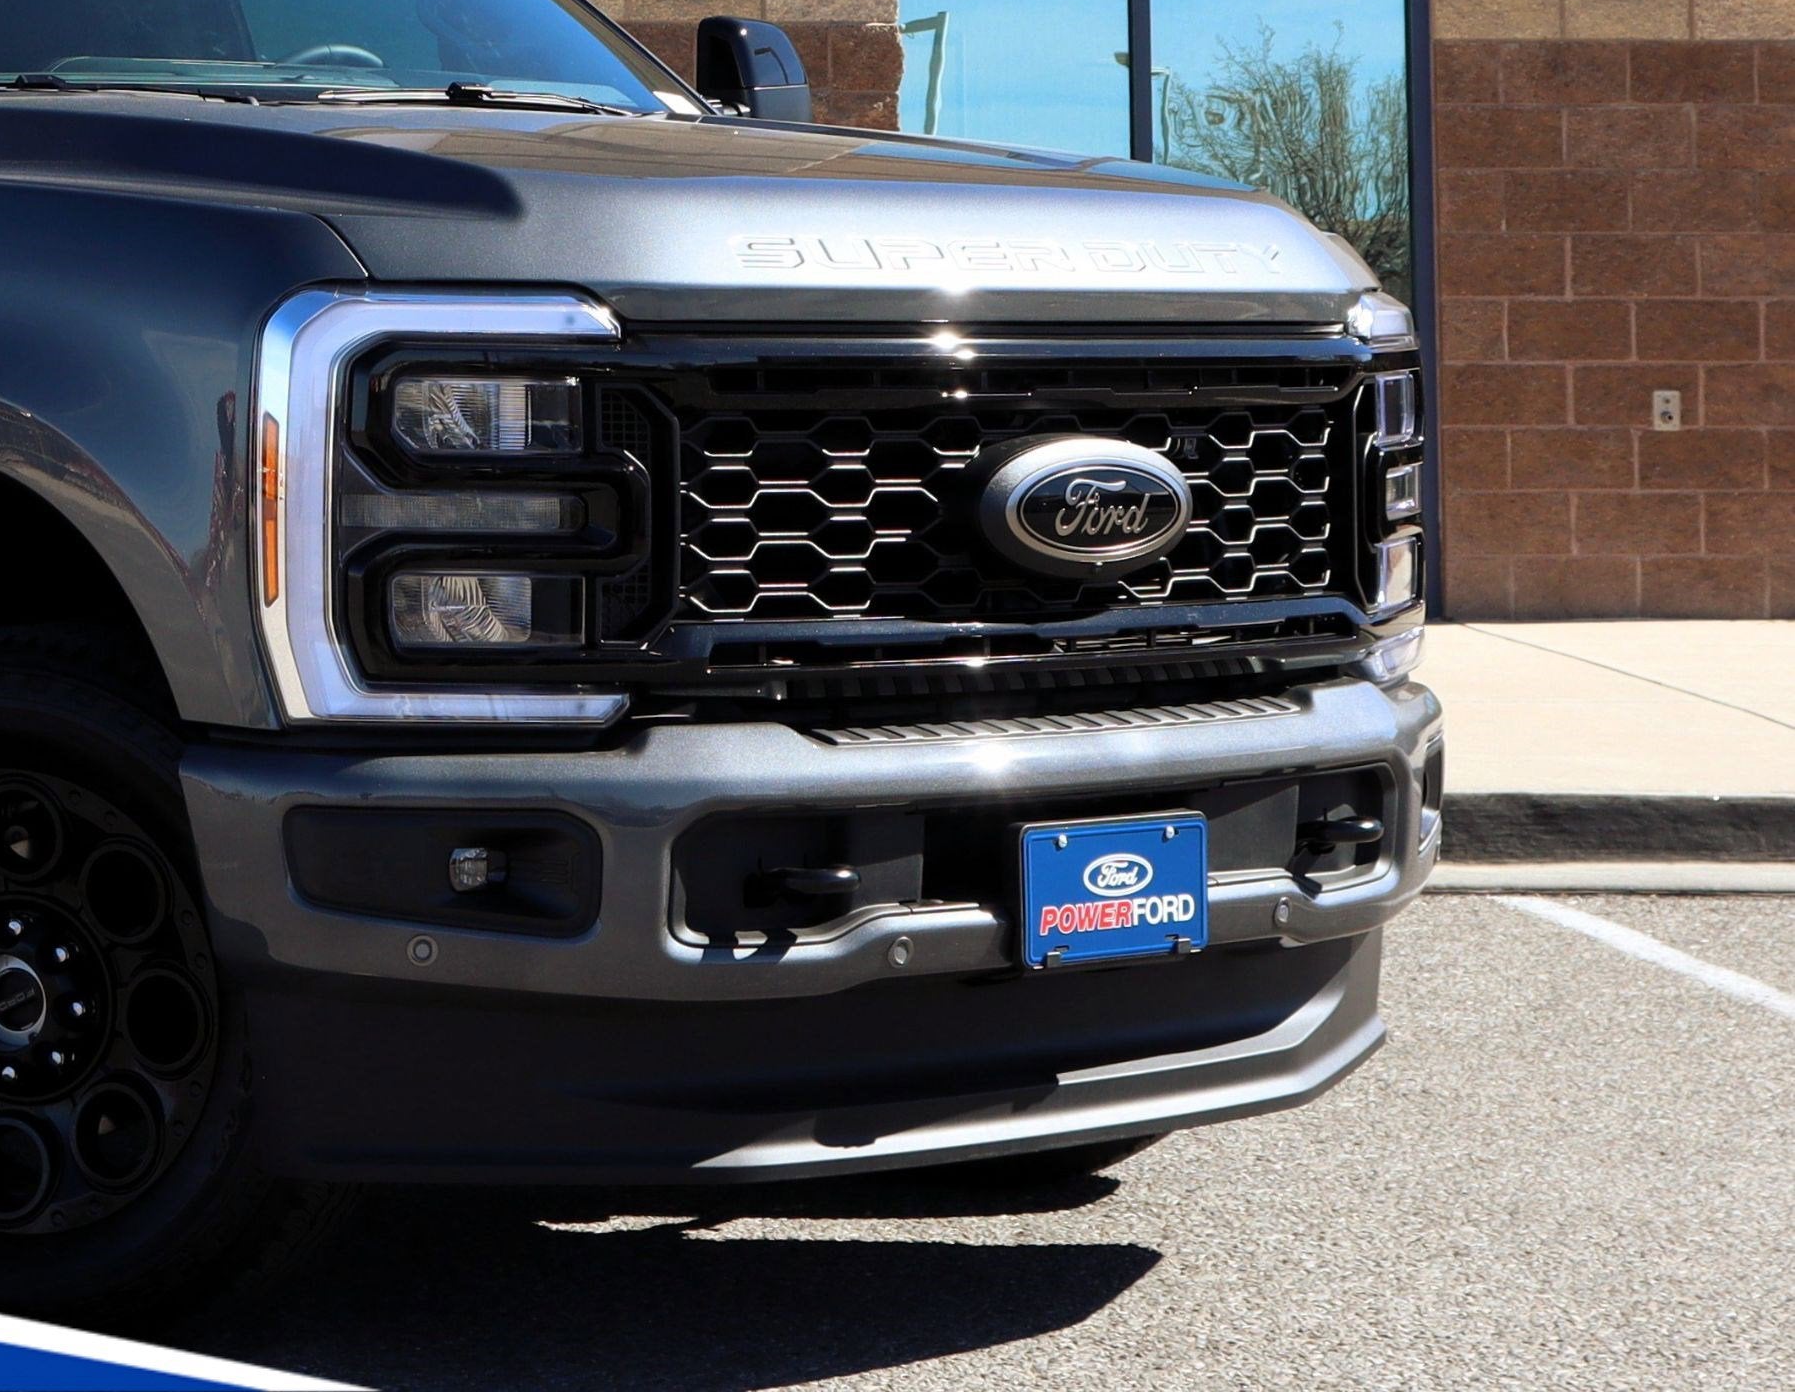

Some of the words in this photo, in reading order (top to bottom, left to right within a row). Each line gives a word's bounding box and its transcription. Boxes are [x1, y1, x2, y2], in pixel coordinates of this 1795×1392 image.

[735, 235, 1076, 273] SUPER
[1080, 240, 1282, 276] DUTY
[1055, 478, 1150, 537] Ford
[1097, 861, 1138, 887] Ford
[1040, 894, 1195, 936] POWERFORD
